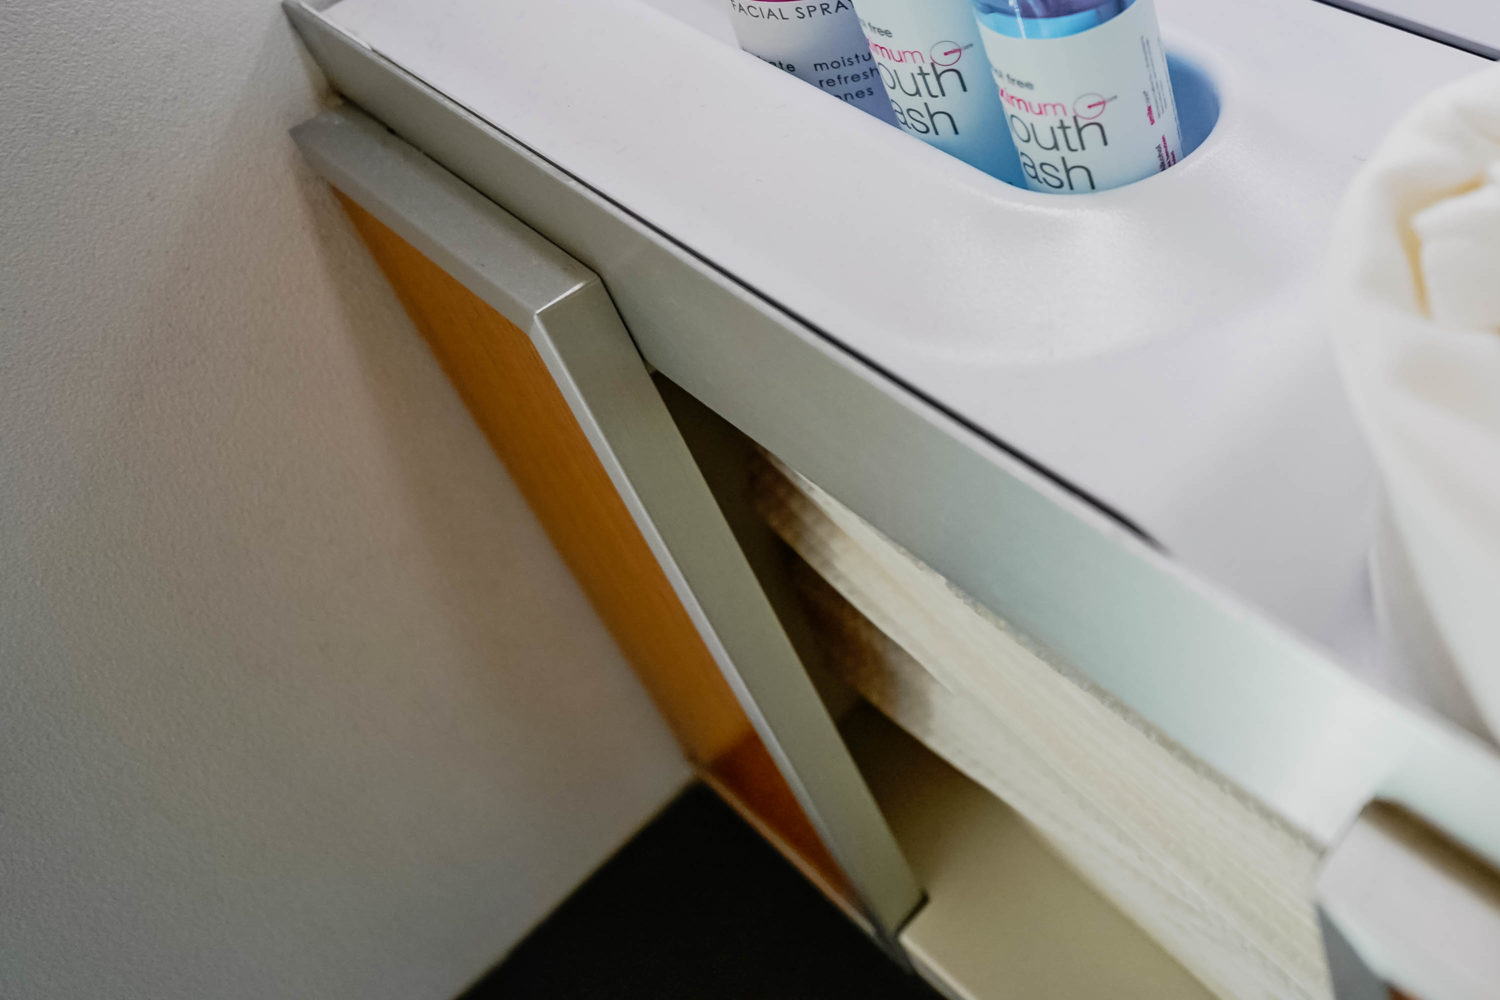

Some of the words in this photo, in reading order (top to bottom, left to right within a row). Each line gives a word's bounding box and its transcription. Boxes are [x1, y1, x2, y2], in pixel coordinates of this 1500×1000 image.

[731, 0, 789, 20] FACIAL
[814, 51, 872, 72] moistu
[818, 68, 880, 88] refresh
[878, 62, 967, 98] outh
[890, 99, 959, 135] ash
[1010, 114, 1108, 152] outh
[1019, 151, 1096, 190] ash
